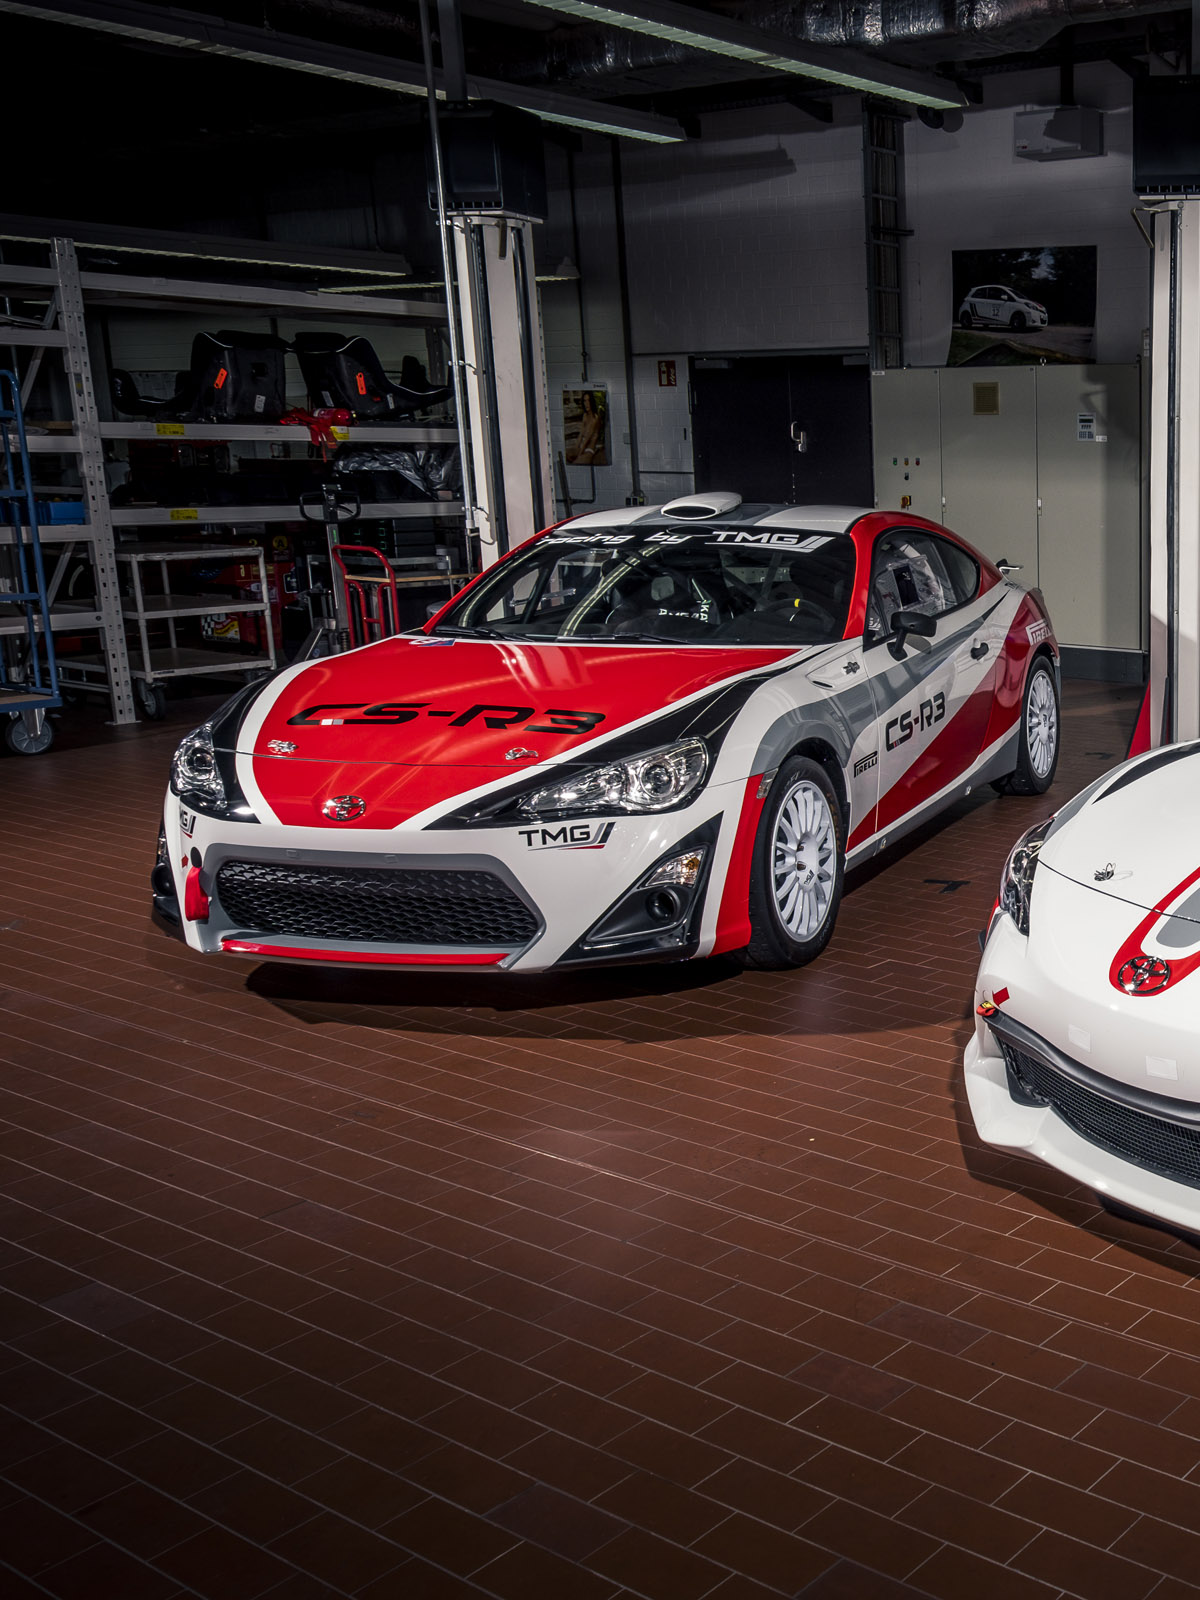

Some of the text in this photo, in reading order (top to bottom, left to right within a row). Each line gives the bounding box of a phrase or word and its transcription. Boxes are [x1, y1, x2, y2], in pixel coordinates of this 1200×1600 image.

[534, 531, 800, 545] racing by TMG
[286, 703, 606, 735] CS-R3
[885, 691, 946, 753] CS-R3
[853, 750, 878, 778] PIRELLI
[518, 824, 592, 848] TMG
